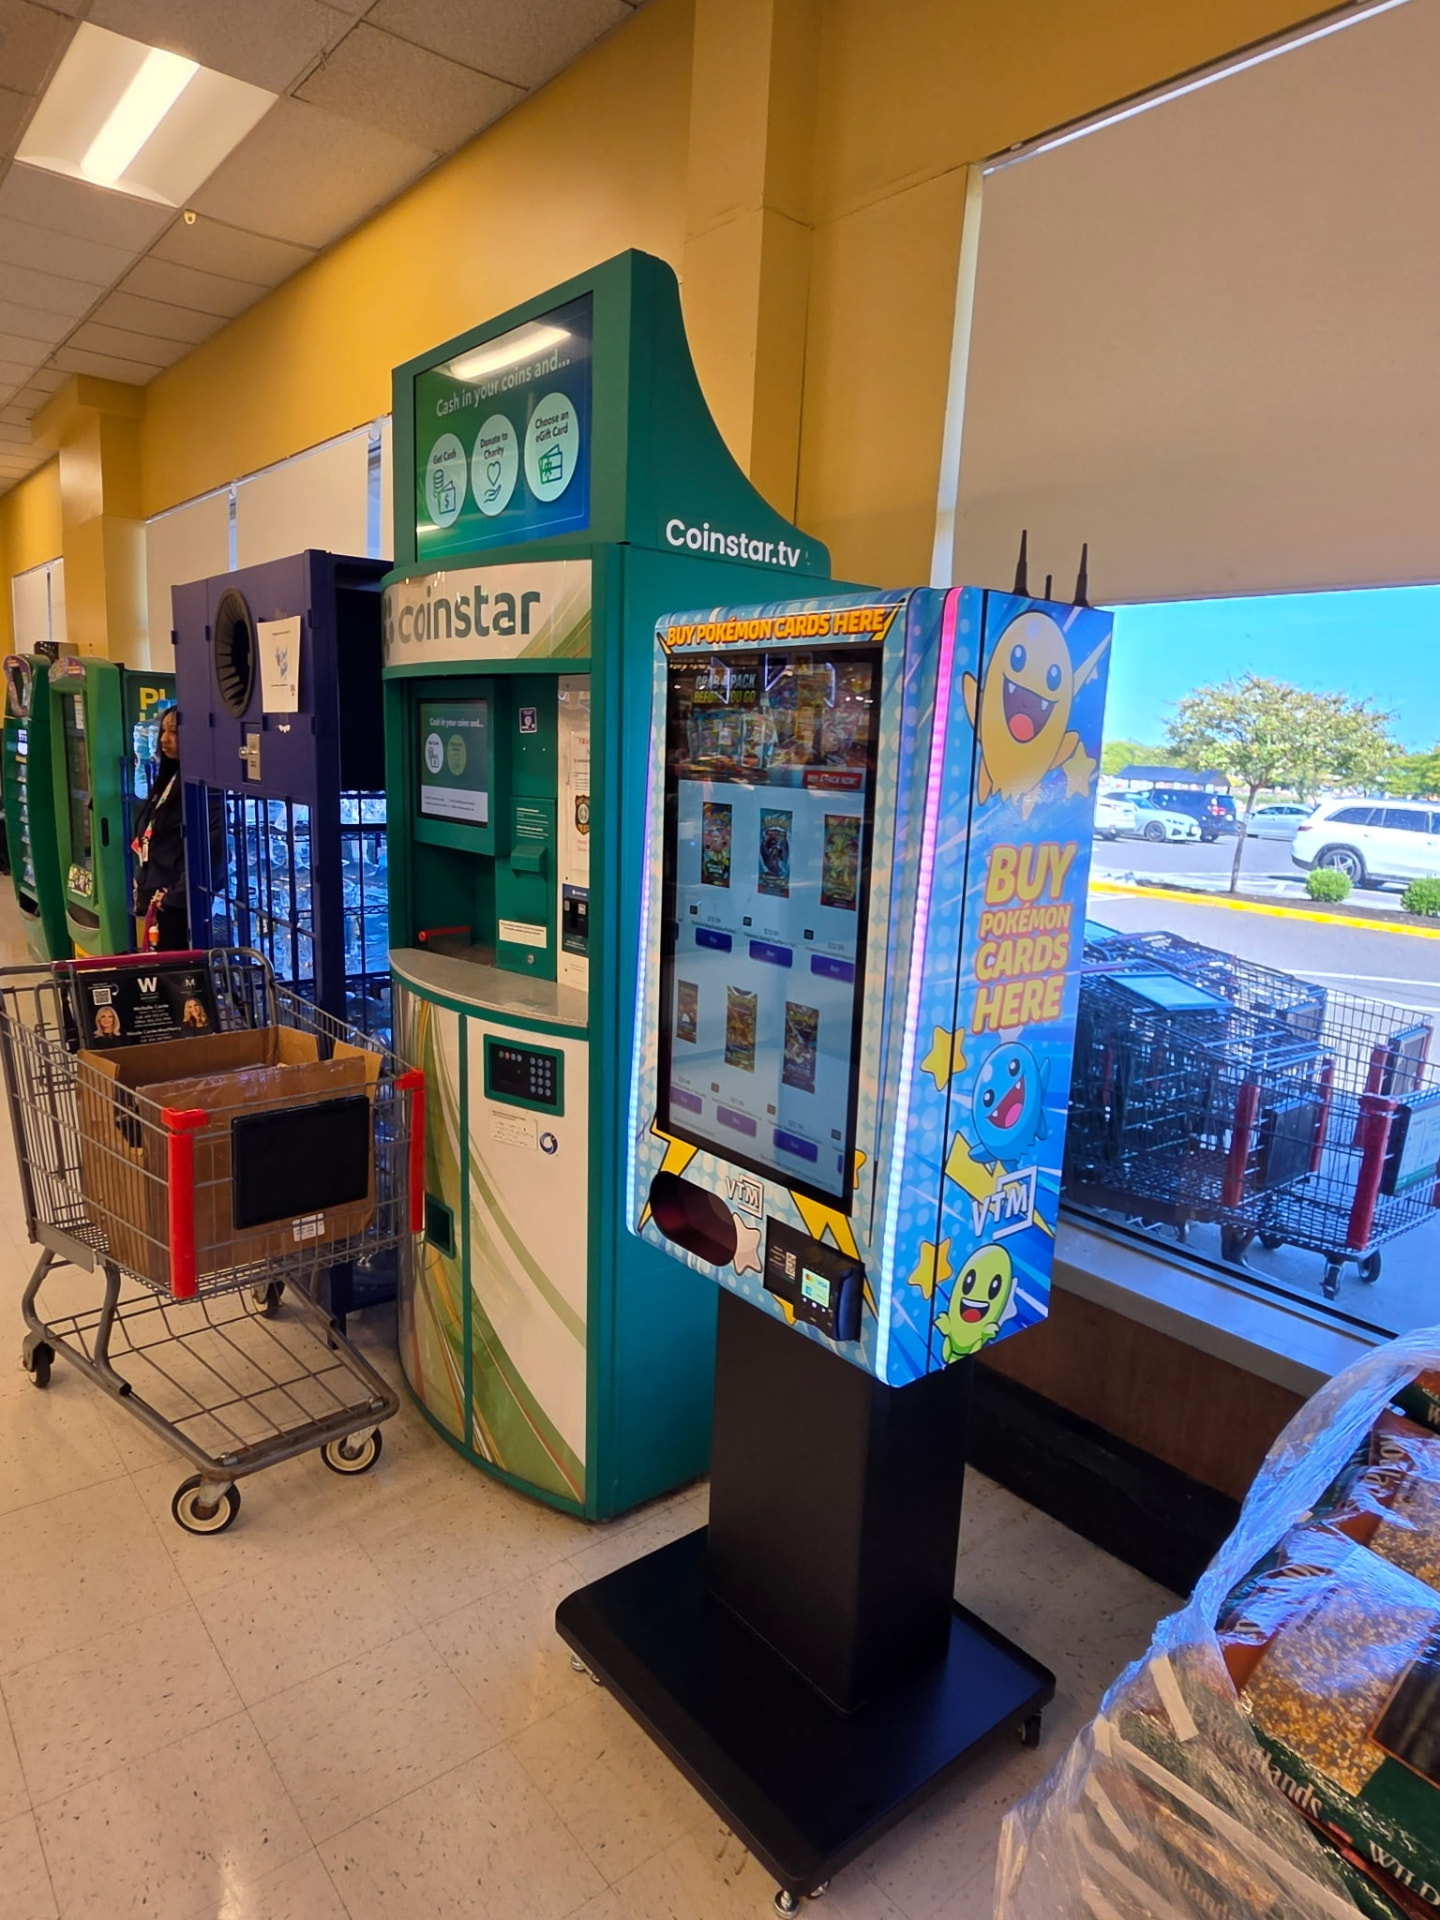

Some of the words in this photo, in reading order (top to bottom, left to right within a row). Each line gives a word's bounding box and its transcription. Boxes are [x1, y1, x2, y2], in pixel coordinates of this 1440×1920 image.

[436, 392, 461, 417] Cash
[462, 388, 472, 408] in
[474, 382, 499, 408] your
[501, 367, 532, 391] coins
[534, 349, 570, 378] and...
[535, 413, 560, 429] Choose
[560, 411, 569, 420] an
[535, 428, 551, 443] eGift
[552, 423, 569, 437] Card
[433, 454, 444, 465] Get
[443, 448, 457, 461] Cash
[480, 435, 501, 448] Donate
[501, 432, 509, 441] to
[483, 445, 505, 460] Charity
[666, 519, 801, 568] Coinstar.tv
[398, 585, 541, 644] coinstar
[666, 625, 697, 646] BUY
[697, 616, 773, 645] POKÉMON
[774, 612, 830, 638] CARDS
[832, 607, 886, 634] HERE
[984, 842, 1077, 906] BUY
[978, 902, 1072, 940] POKÉMON
[975, 932, 1070, 982] CARDS
[137, 977, 157, 993] W
[972, 973, 1065, 1035] HERE
[725, 1175, 761, 1209] VTM
[972, 1183, 1030, 1238] VTM
[1368, 1839, 1440, 1907] WILD
